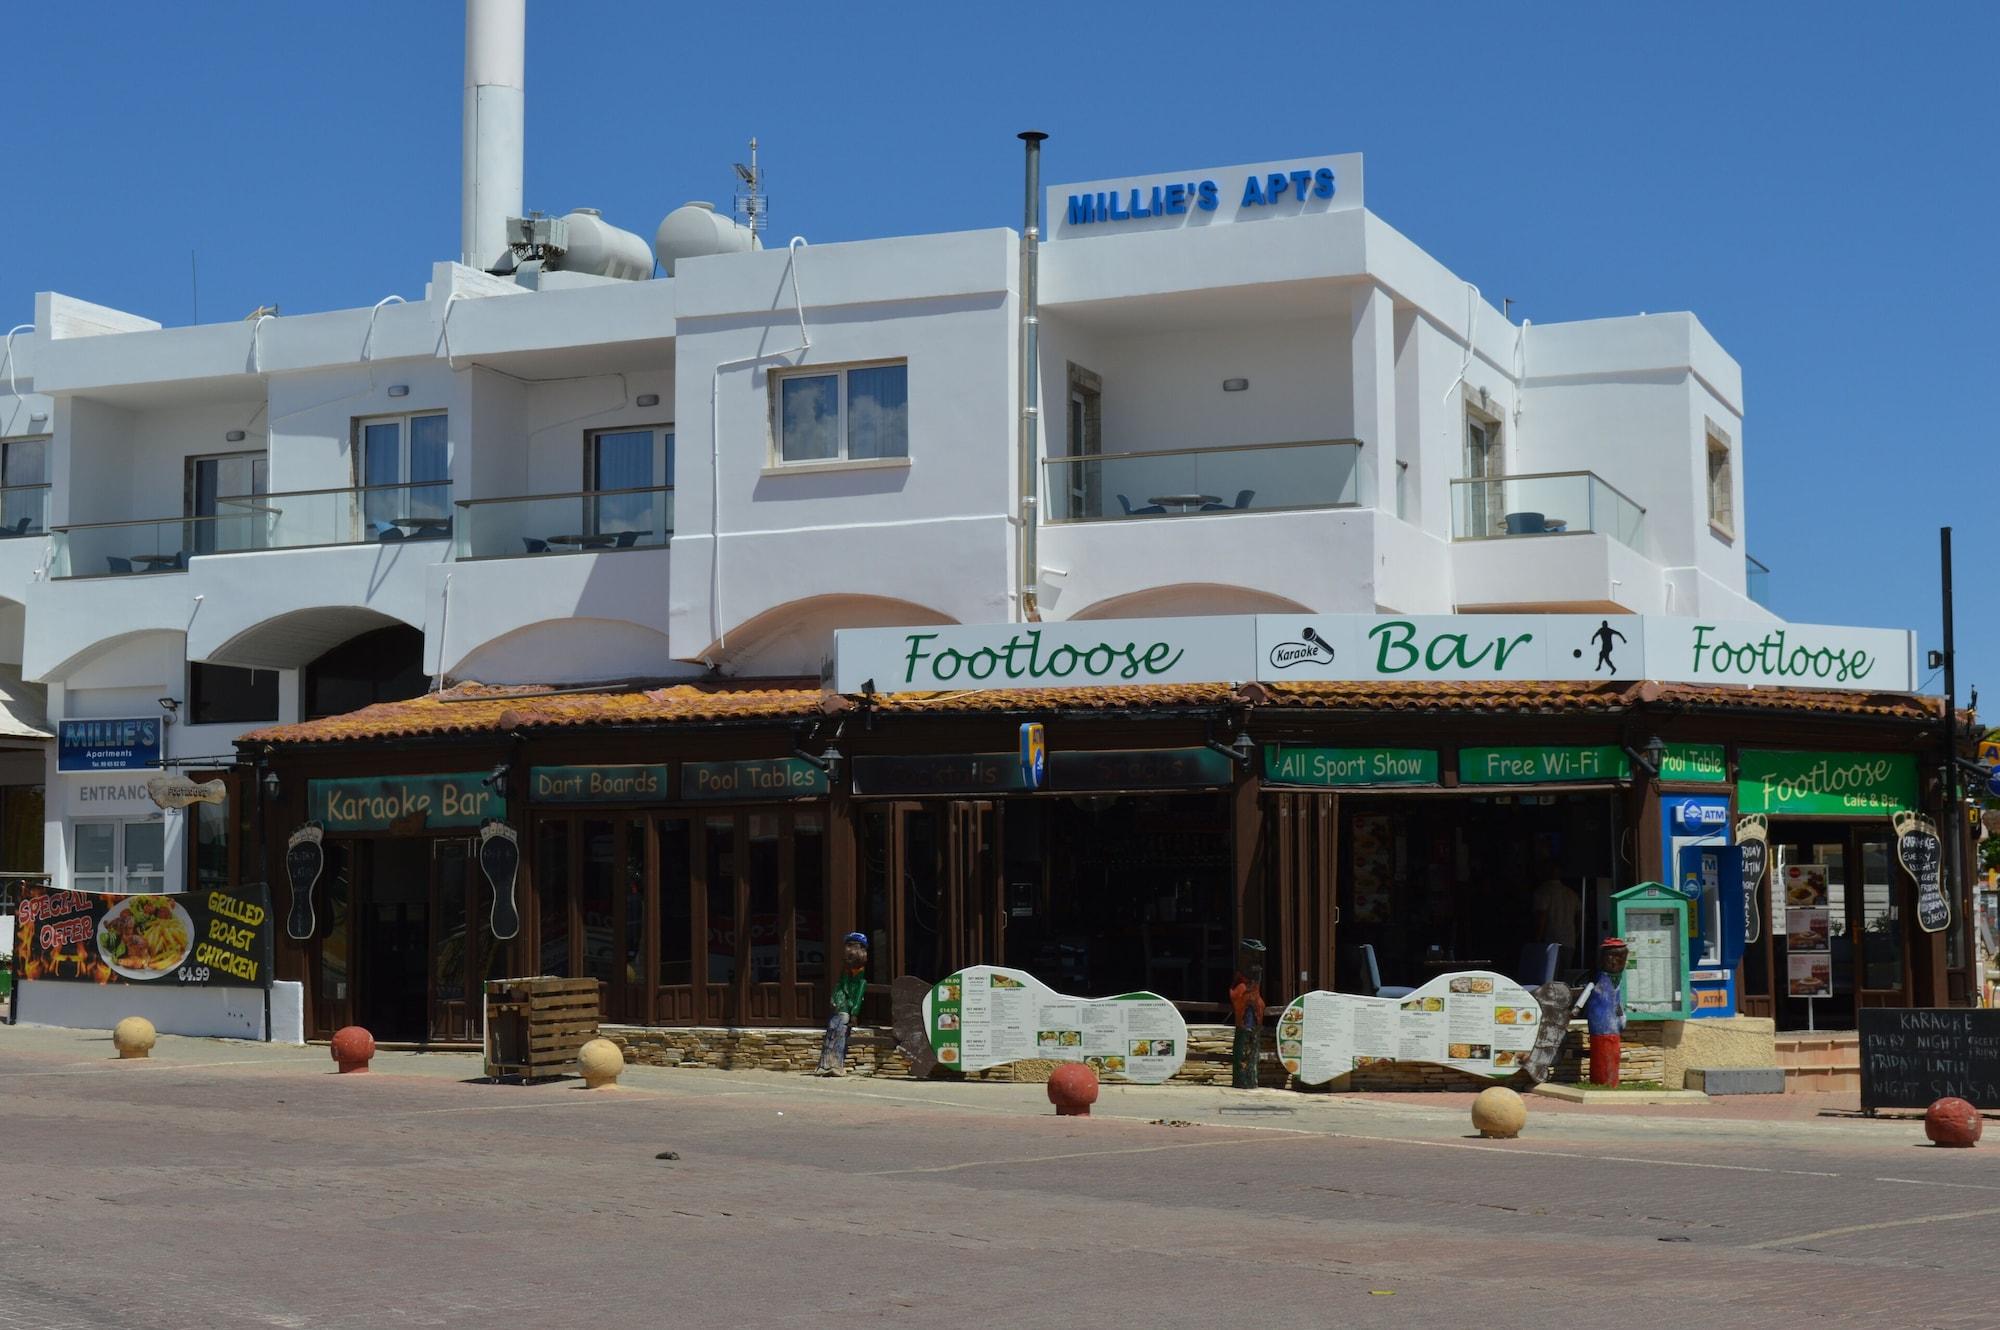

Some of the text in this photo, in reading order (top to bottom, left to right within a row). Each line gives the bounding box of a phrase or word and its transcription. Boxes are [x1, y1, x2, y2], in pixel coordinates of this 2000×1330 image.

[1068, 167, 1336, 225] MILLIE'S APTS
[904, 630, 1184, 683] Footloose
[1276, 645, 1319, 662] Karaoke
[1368, 620, 1534, 674] Bar
[1692, 625, 1875, 682] Footloose
[64, 719, 155, 747] MILLIE'S
[86, 750, 132, 759] Apartments
[1281, 749, 1423, 785] All Sport Show
[1488, 751, 1599, 776] Free Wi-Fi
[1662, 749, 1722, 773] Pool Table
[538, 771, 657, 795] Dart Boards
[698, 764, 815, 790] Pool Tables
[1761, 760, 1892, 810] Footloose
[327, 783, 489, 822] Karaoke Bar
[1844, 793, 1899, 807] Café & Bar
[1704, 811, 1724, 820] ATM
[18, 890, 94, 926] SPECIAL
[208, 891, 265, 927] GRILLED
[40, 916, 94, 950] OFFER
[209, 918, 255, 951] ROAST
[178, 966, 209, 983] €4.99
[195, 942, 259, 982] CHICKEN
[1703, 995, 1723, 1004] ATM
[1900, 1011, 1974, 1032] KARAOKE
[1917, 1034, 1960, 1049] NIGHT
[1930, 1080, 1999, 1100] SALSA
